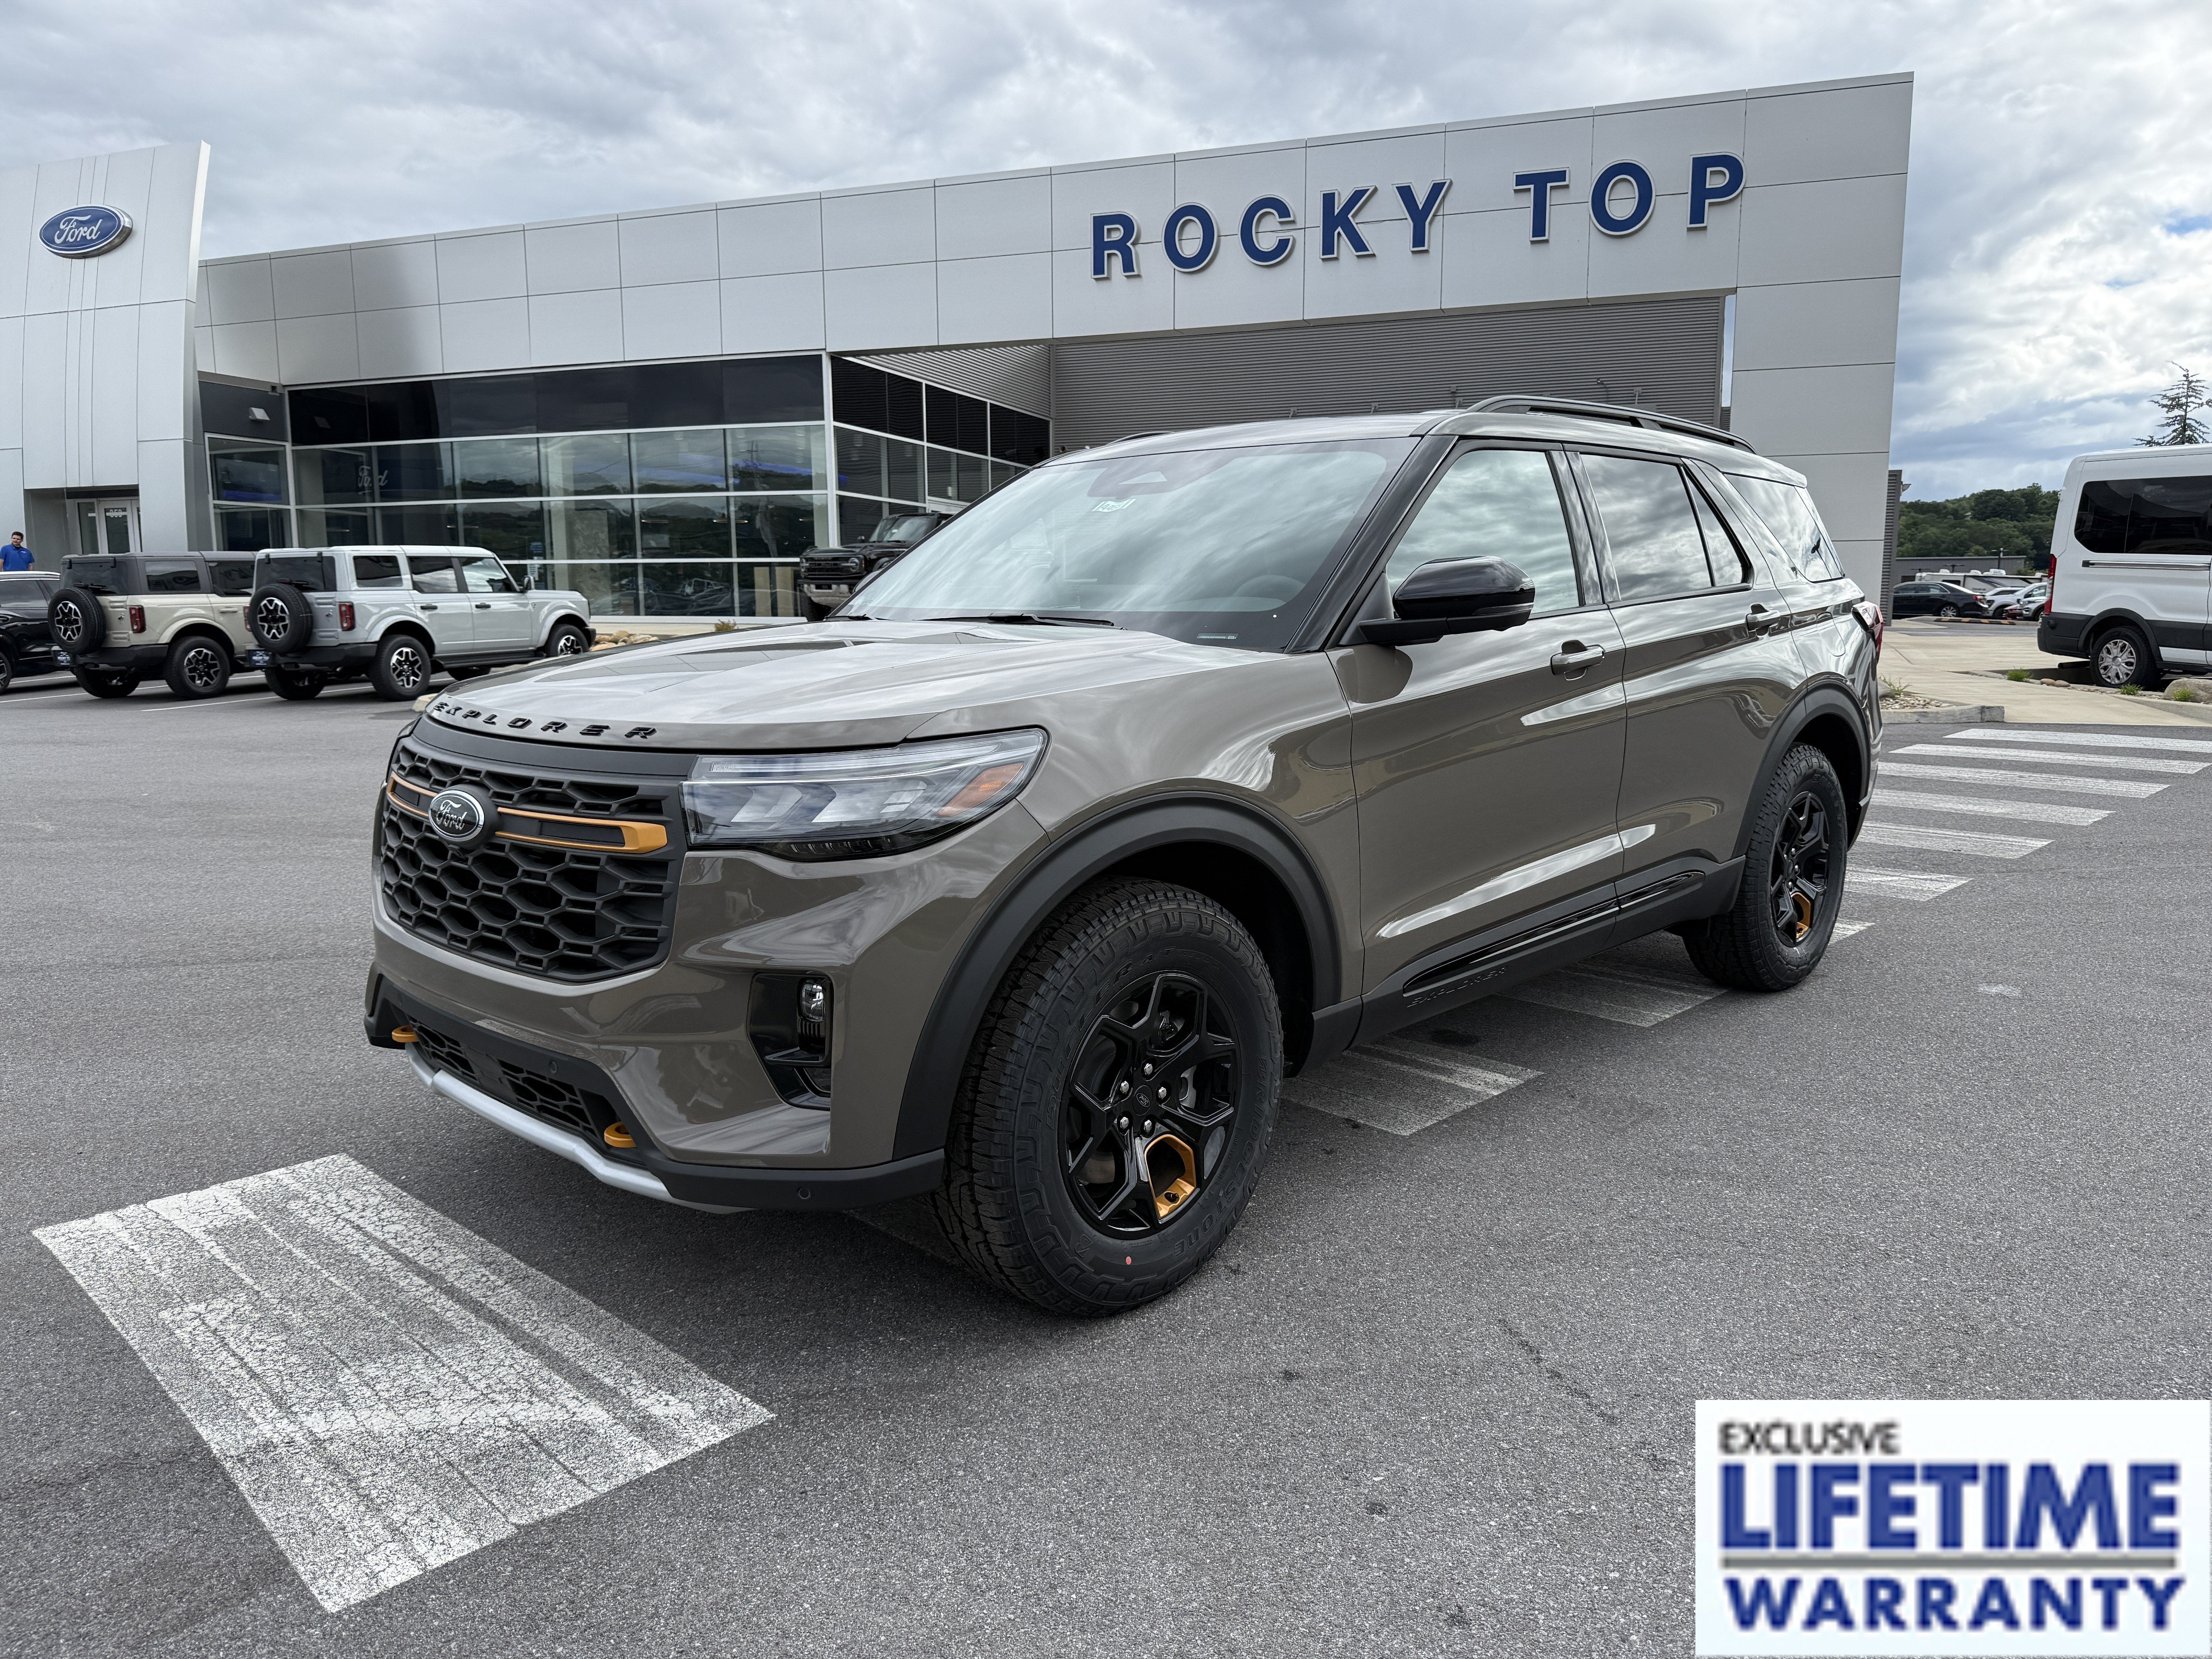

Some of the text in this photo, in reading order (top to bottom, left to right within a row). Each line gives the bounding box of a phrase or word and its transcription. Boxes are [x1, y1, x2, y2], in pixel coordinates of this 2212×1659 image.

[54, 215, 103, 244] Ford
[1090, 152, 1746, 280] ROCKY TOP
[357, 465, 388, 488] Fod
[433, 701, 657, 739] EXPLORER
[436, 799, 468, 831] Ford
[1172, 1056, 1267, 1261] BRIDGESTONE
